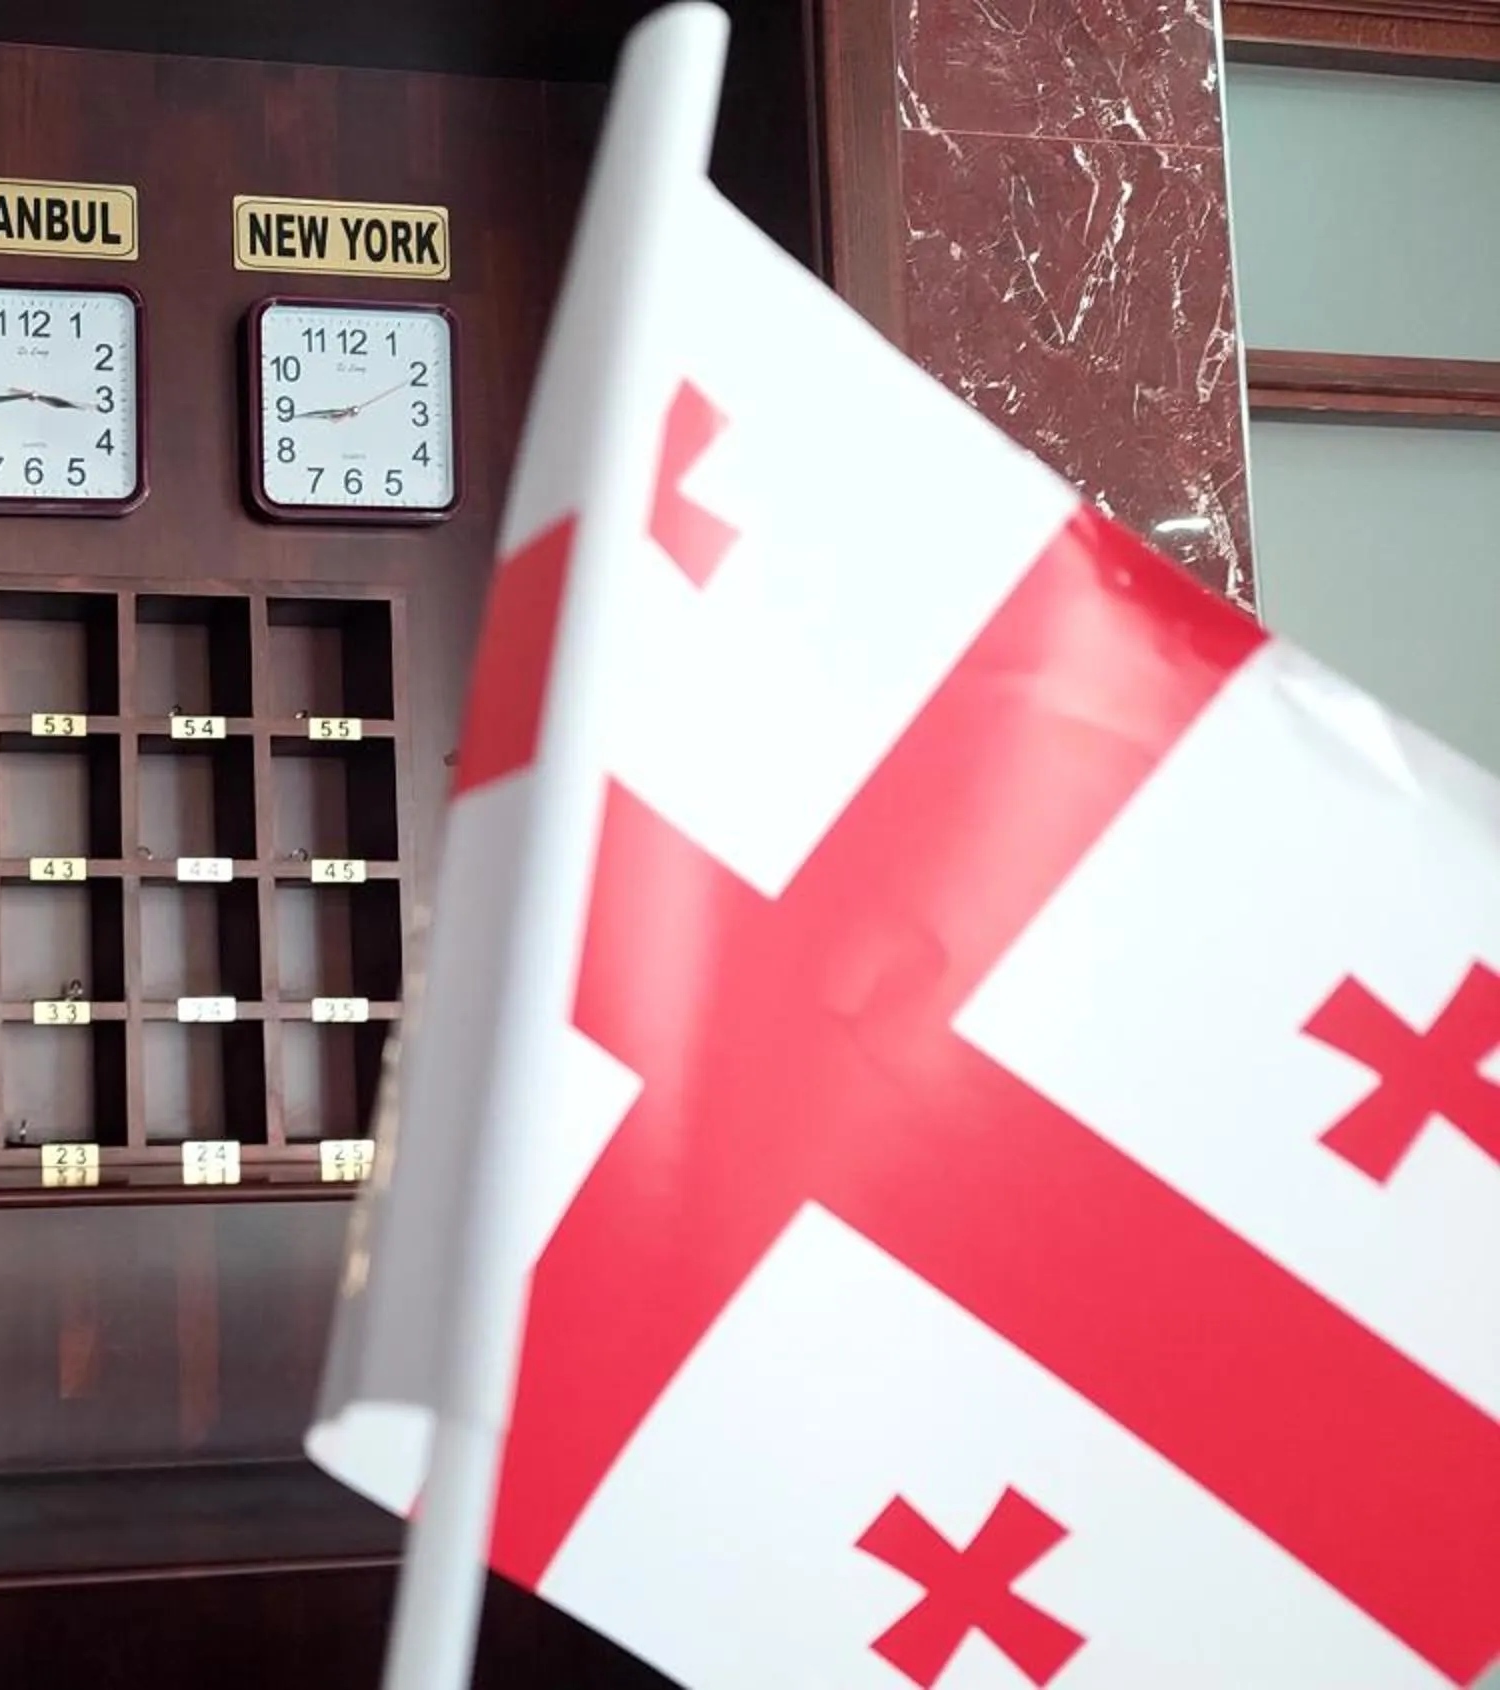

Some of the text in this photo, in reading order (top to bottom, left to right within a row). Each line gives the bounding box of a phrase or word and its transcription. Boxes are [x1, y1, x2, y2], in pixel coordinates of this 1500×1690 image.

[250, 213, 439, 264] NEW YORK
[19, 310, 50, 337] 12
[70, 313, 80, 338] 1
[302, 328, 324, 352] 11
[338, 329, 367, 355] 12
[386, 332, 396, 356] 1
[96, 344, 113, 371] 2
[271, 356, 300, 382] 10
[411, 362, 428, 386] 2
[96, 386, 114, 413] 3
[276, 396, 294, 422] 9
[412, 401, 428, 426] 3
[96, 429, 114, 455] 4
[278, 437, 295, 463] 8
[412, 442, 430, 466] 4
[25, 458, 43, 484] 6
[68, 458, 85, 486] 5
[308, 468, 324, 493] 7
[344, 469, 362, 494] 6
[386, 470, 402, 496] 5
[43, 715, 76, 735] 53
[183, 718, 214, 736] 54
[320, 719, 351, 737] 55
[42, 860, 73, 877] 43
[188, 861, 219, 877] 44
[324, 862, 355, 879] 45
[47, 1003, 78, 1022] 33
[324, 1001, 355, 1019] 35
[54, 1147, 88, 1165] 23
[196, 1144, 228, 1163] 24
[333, 1143, 365, 1161] 25
